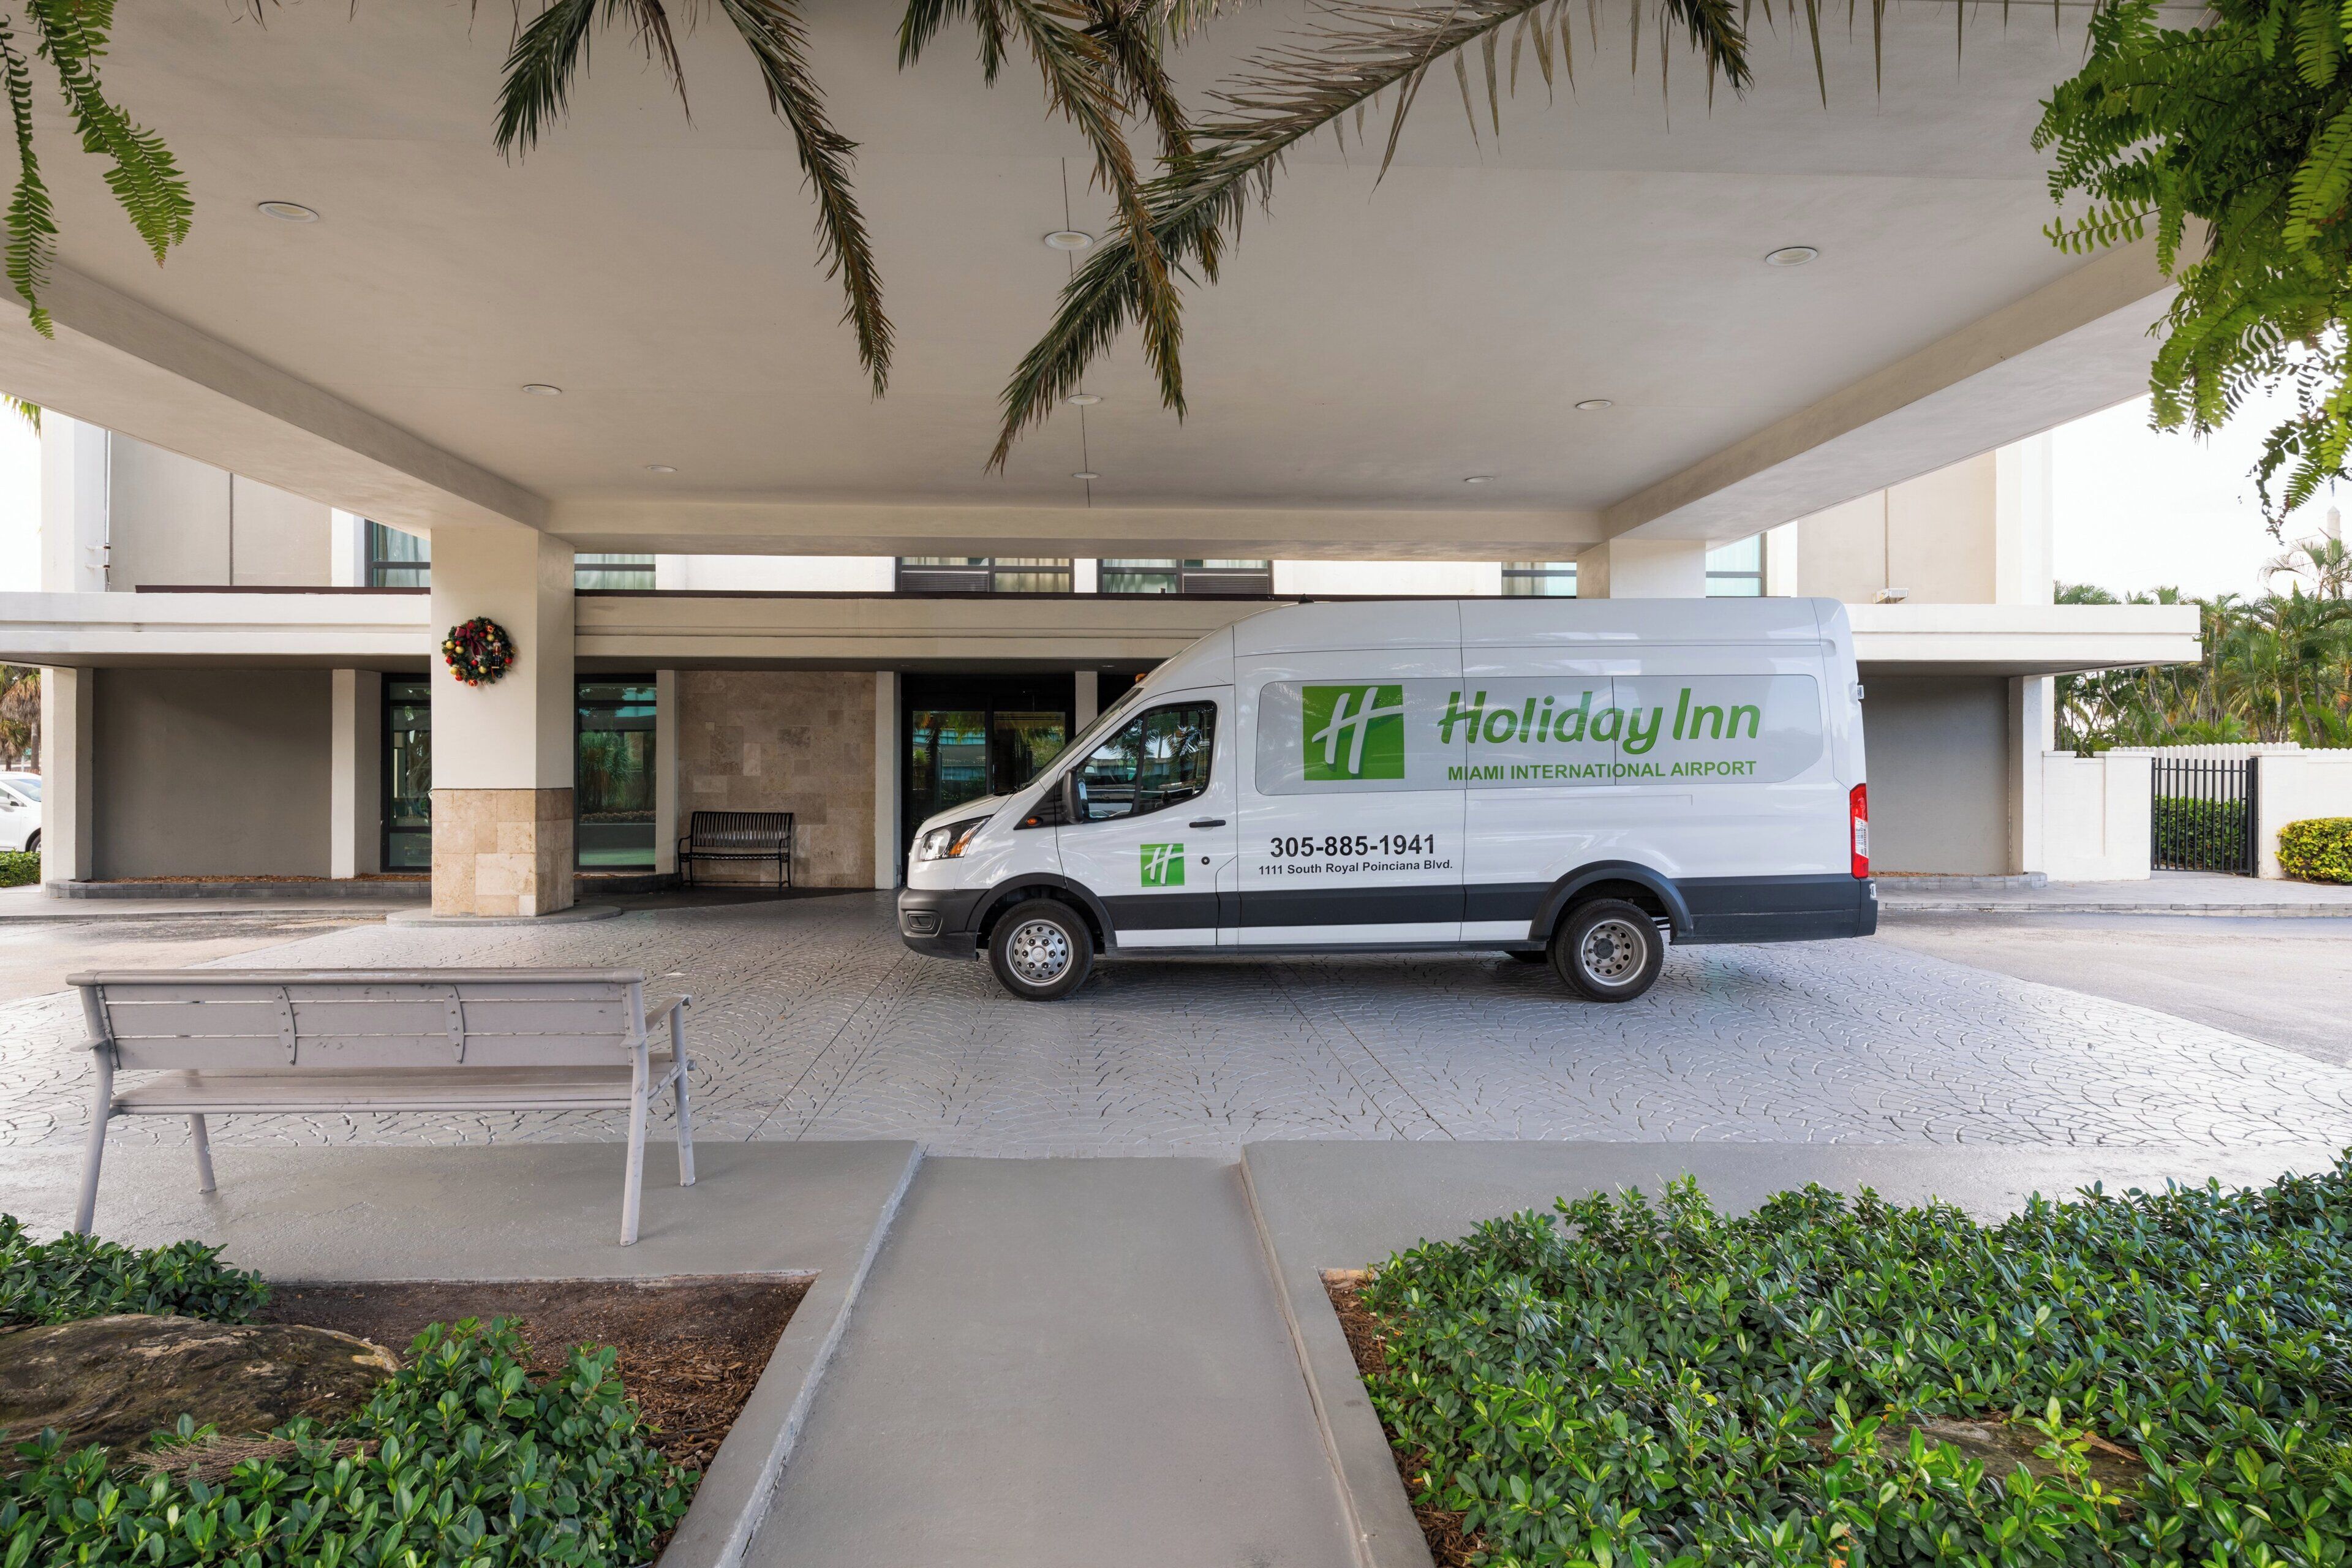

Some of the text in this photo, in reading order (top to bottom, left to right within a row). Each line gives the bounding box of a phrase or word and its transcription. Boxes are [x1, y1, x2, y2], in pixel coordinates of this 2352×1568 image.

[1437, 688, 1760, 755] Holiday Inn
[1447, 761, 1757, 780] MIAMI INTERNATIONAL AIRPORT
[1270, 834, 1434, 858] 305-885-1941
[1259, 859, 1453, 875] 1111 South Royal Poinciana Blvd.
